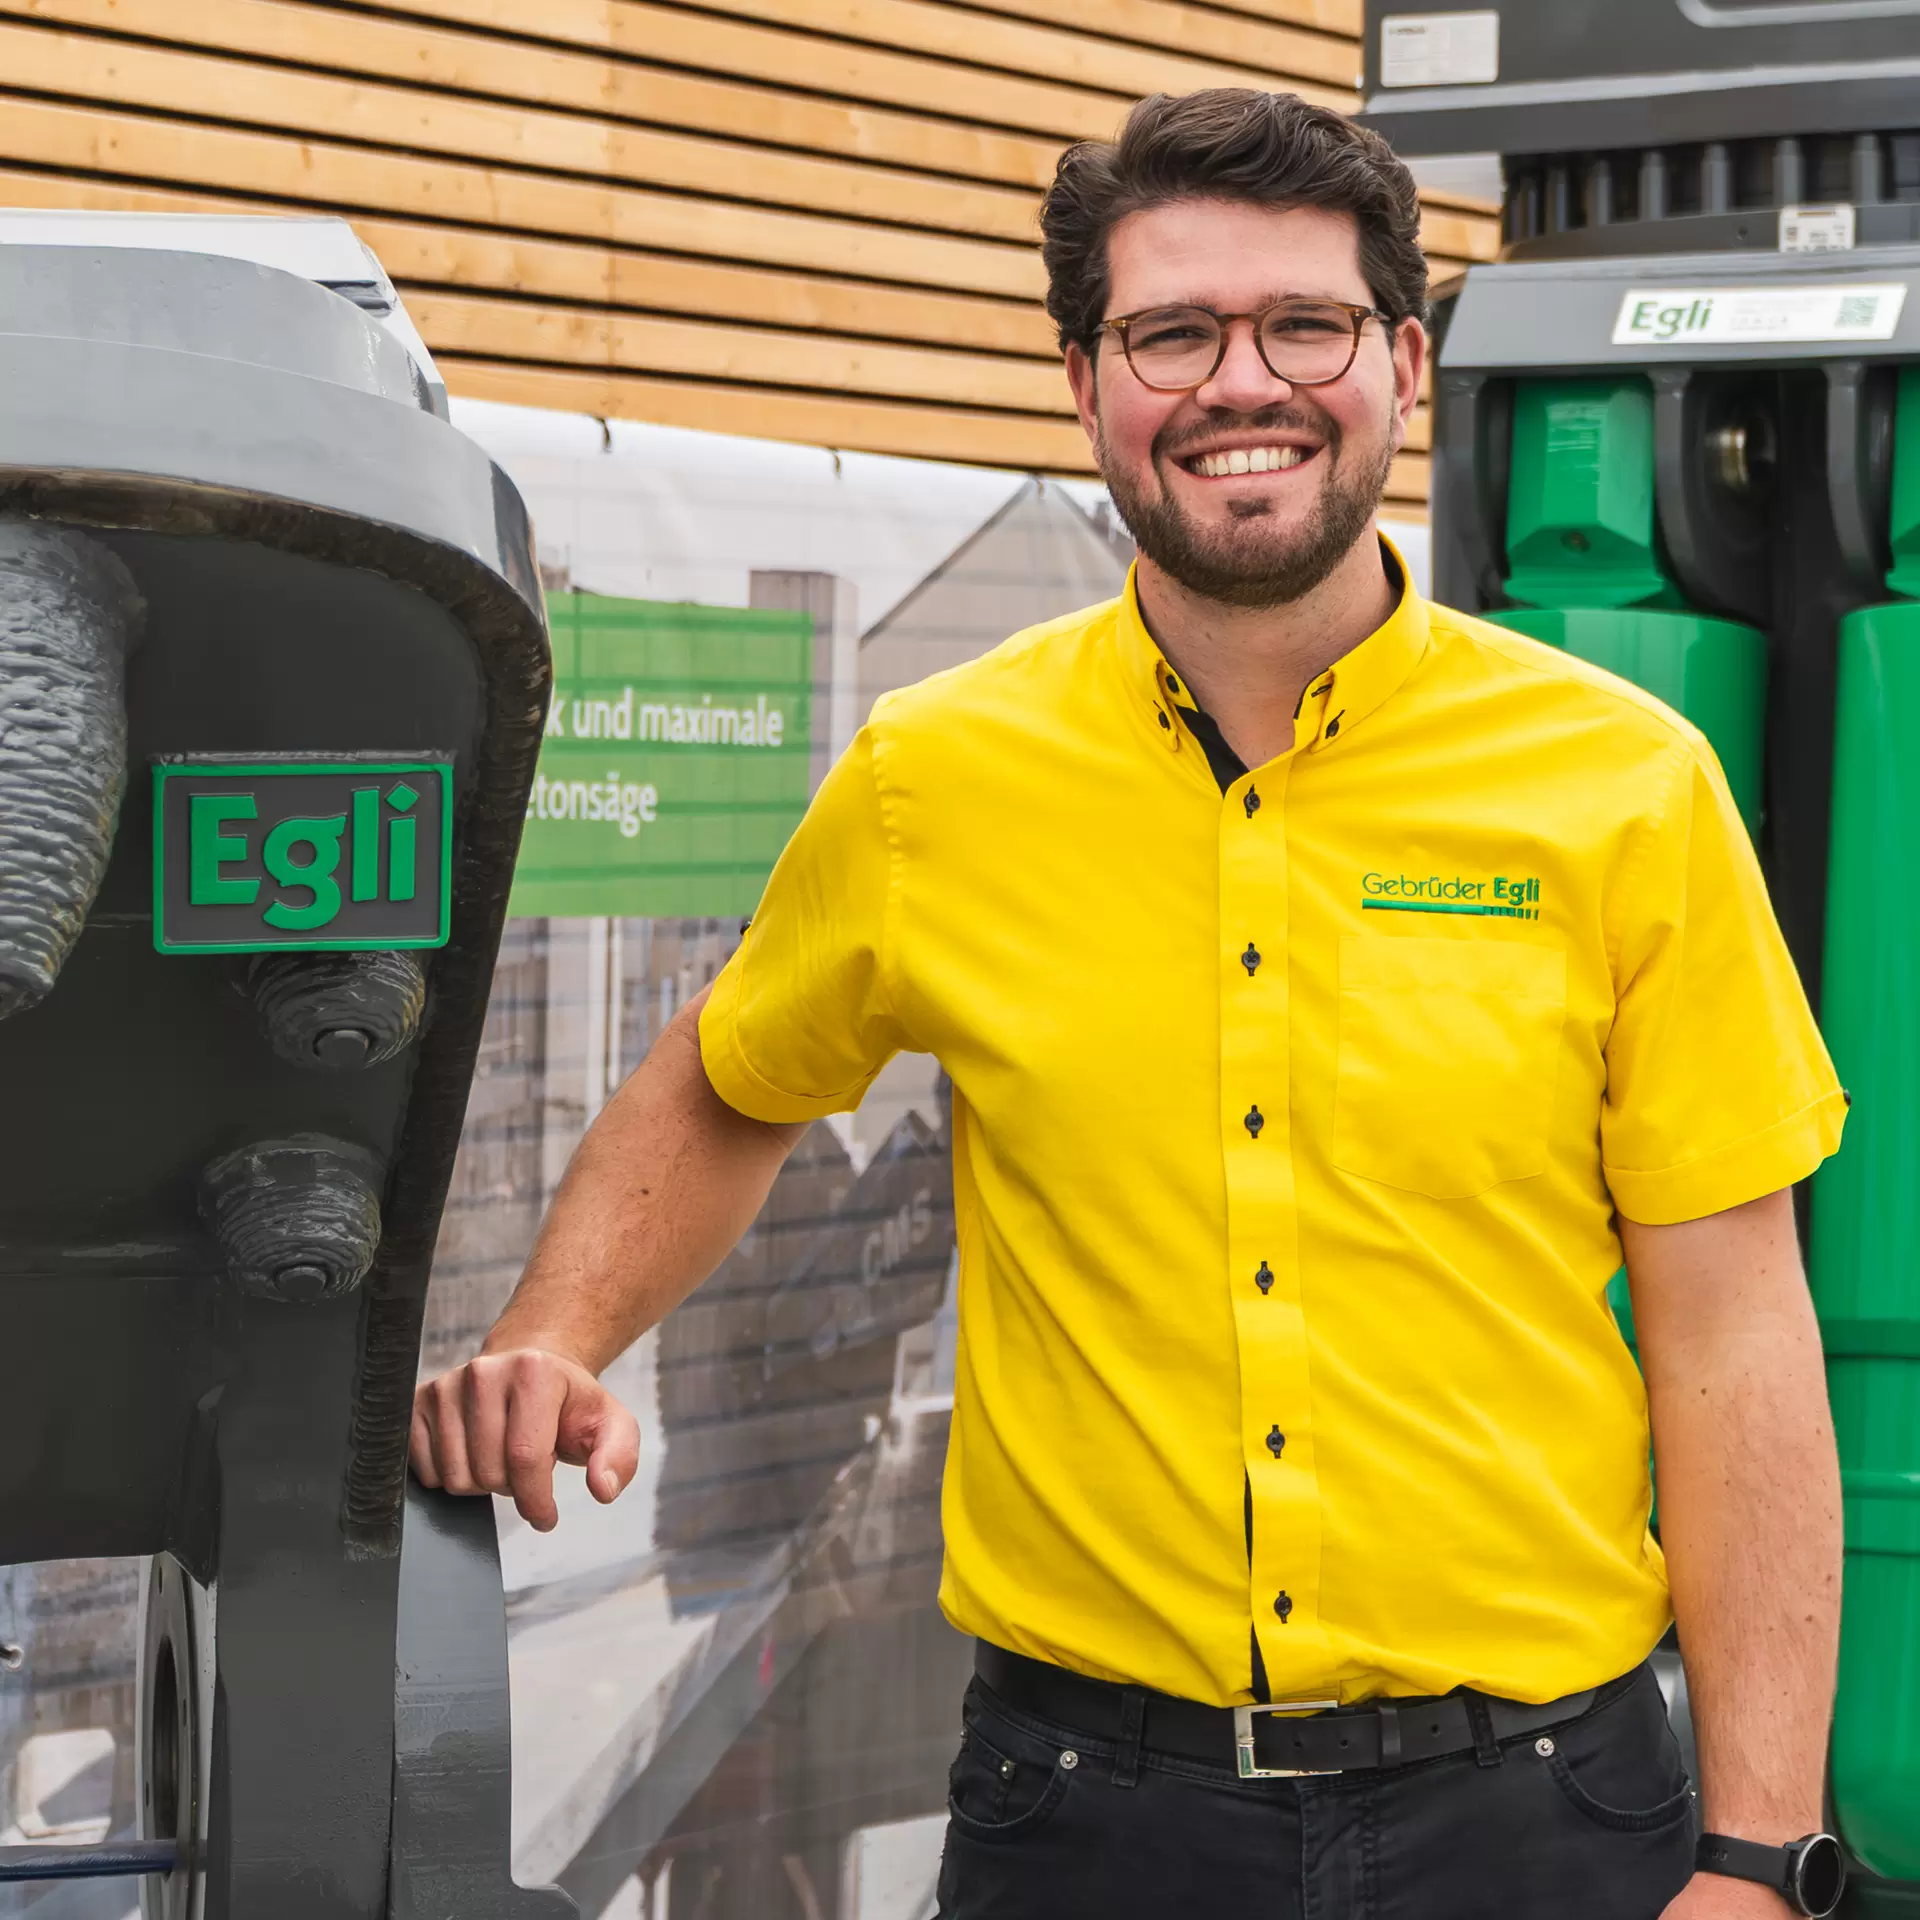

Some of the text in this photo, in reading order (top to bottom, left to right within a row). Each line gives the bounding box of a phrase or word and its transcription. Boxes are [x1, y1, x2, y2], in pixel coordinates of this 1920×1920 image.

[1629, 299, 1713, 338] Egli
[574, 684, 633, 740] und
[639, 694, 784, 746] maximale
[189, 780, 420, 931] Egli
[1362, 873, 1540, 906] Gebrüder Egli
